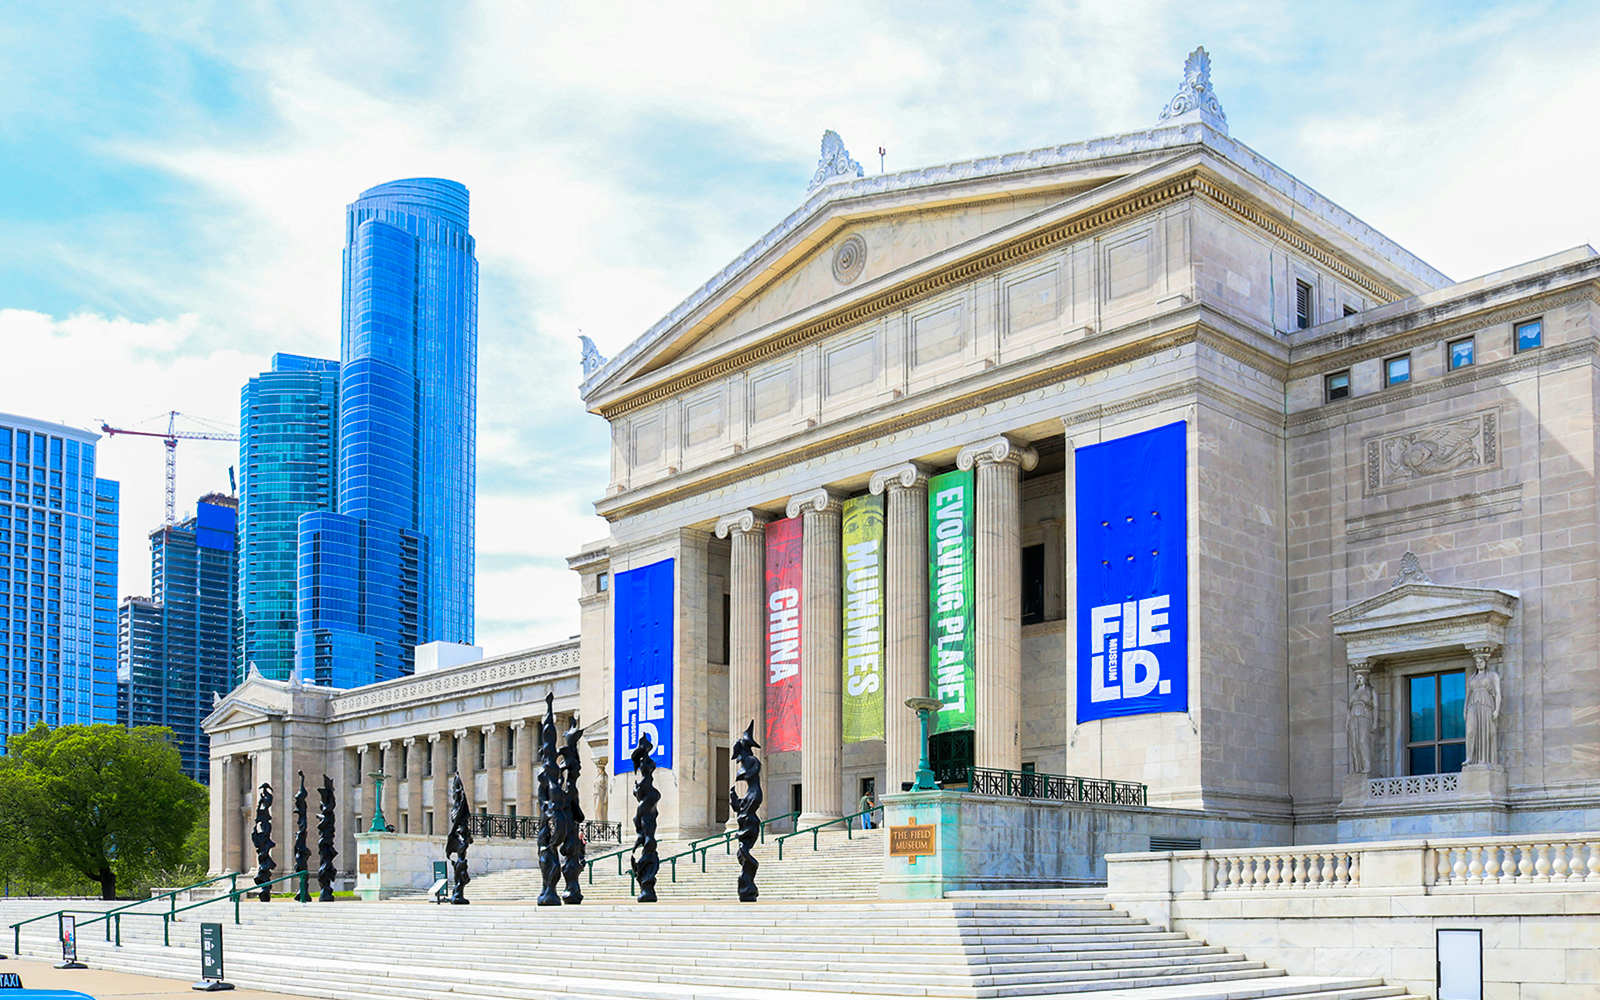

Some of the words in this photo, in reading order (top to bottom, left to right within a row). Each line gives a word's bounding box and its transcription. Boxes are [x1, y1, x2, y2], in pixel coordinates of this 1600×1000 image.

[936, 485, 964, 613] EVOLVING
[769, 587, 799, 685] CHINA
[846, 538, 880, 697] MUMMIES
[937, 615, 966, 714] PLANET
[1109, 638, 1118, 681] MUSEUM
[893, 831, 908, 839] THE
[910, 830, 931, 839] FIELD
[895, 841, 928, 850] MUSEUM
